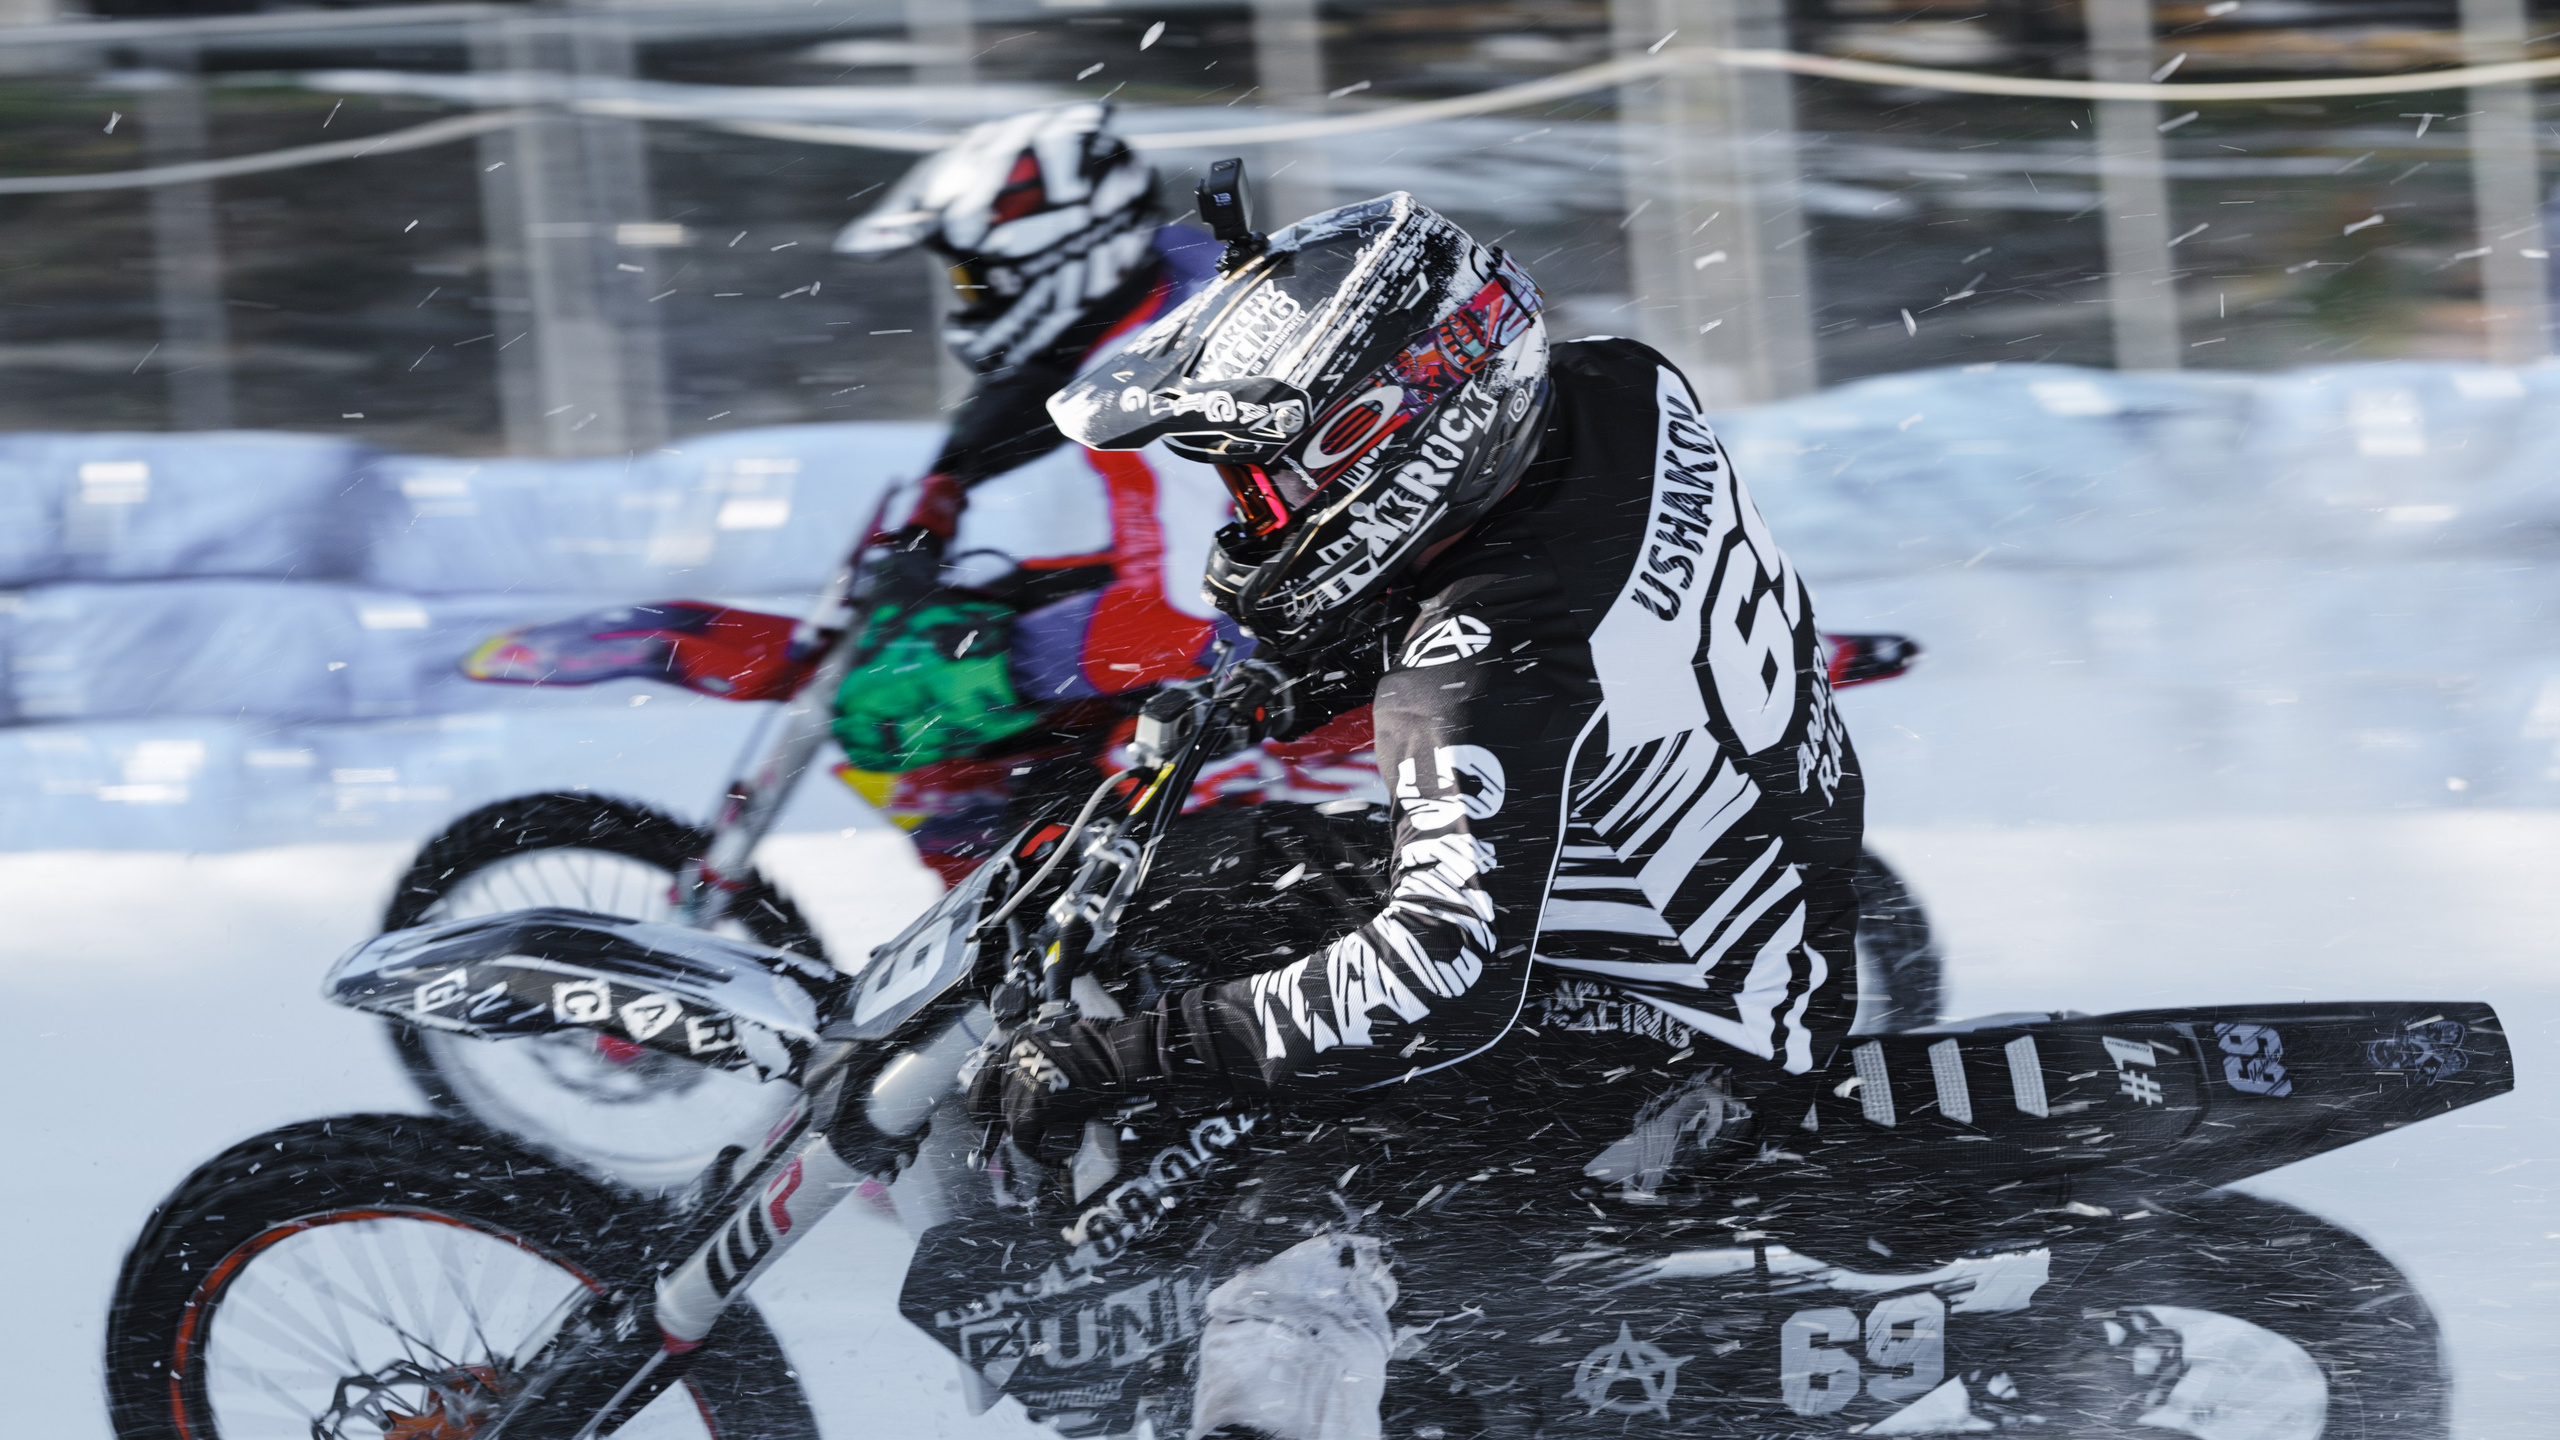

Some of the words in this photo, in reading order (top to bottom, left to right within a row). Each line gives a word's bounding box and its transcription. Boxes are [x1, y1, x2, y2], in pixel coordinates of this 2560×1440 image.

[1217, 294, 1300, 380] ACING
[1706, 538, 1800, 757] 6
[1008, 1039, 1070, 1095] FXR
[1780, 1291, 1946, 1417] 69
